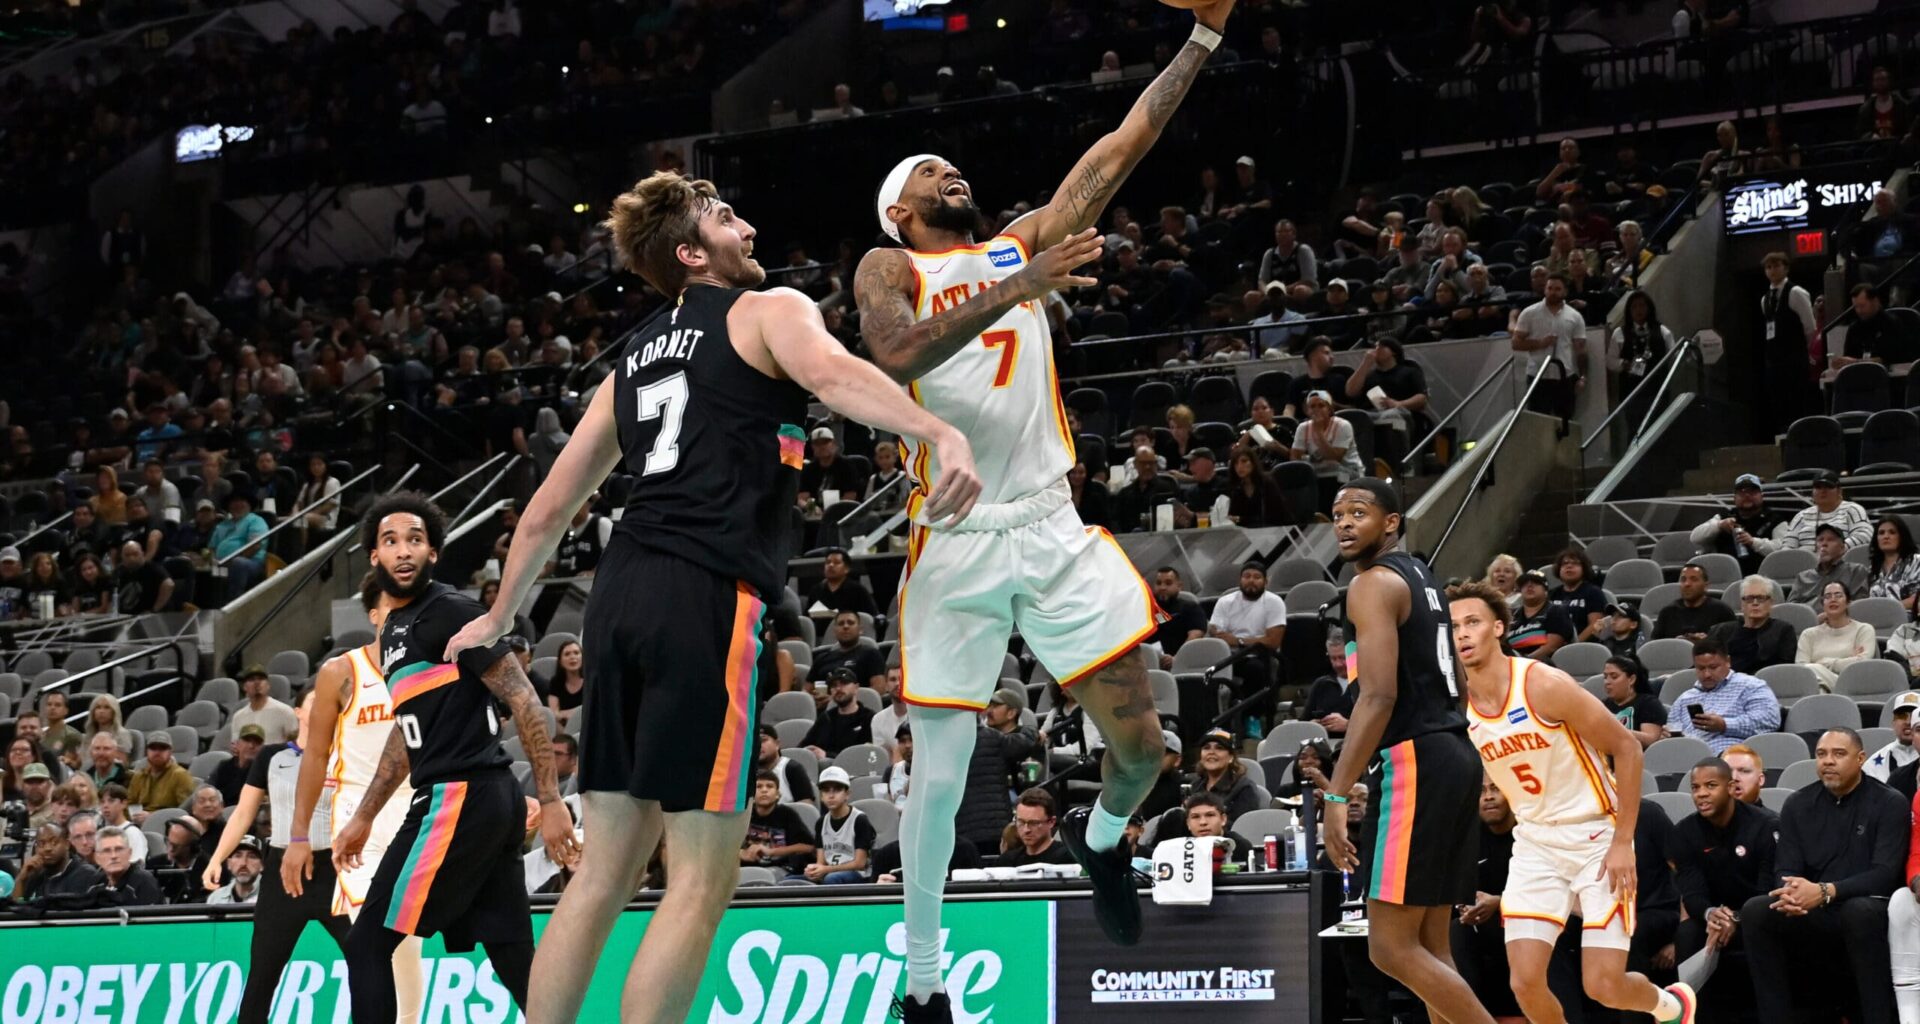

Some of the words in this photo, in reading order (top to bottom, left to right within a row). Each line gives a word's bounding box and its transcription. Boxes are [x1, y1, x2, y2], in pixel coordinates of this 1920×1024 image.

[1731, 178, 1809, 225] Shiner
[991, 252, 1017, 264] paze
[1796, 232, 1823, 254] EXIT
[627, 329, 704, 378] KORNET
[981, 328, 1021, 390] 7
[636, 370, 690, 477] 7
[357, 703, 395, 725] ATL
[396, 713, 422, 748] 0
[1510, 763, 1542, 795] 5
[1183, 837, 1195, 883] GATO
[2, 963, 161, 1024] OBEY
[1091, 968, 1215, 991] COMMUNITY
[1219, 967, 1275, 989] FIRST
[1119, 991, 1182, 1001] HEALTH
[1194, 990, 1247, 999] PLANS
